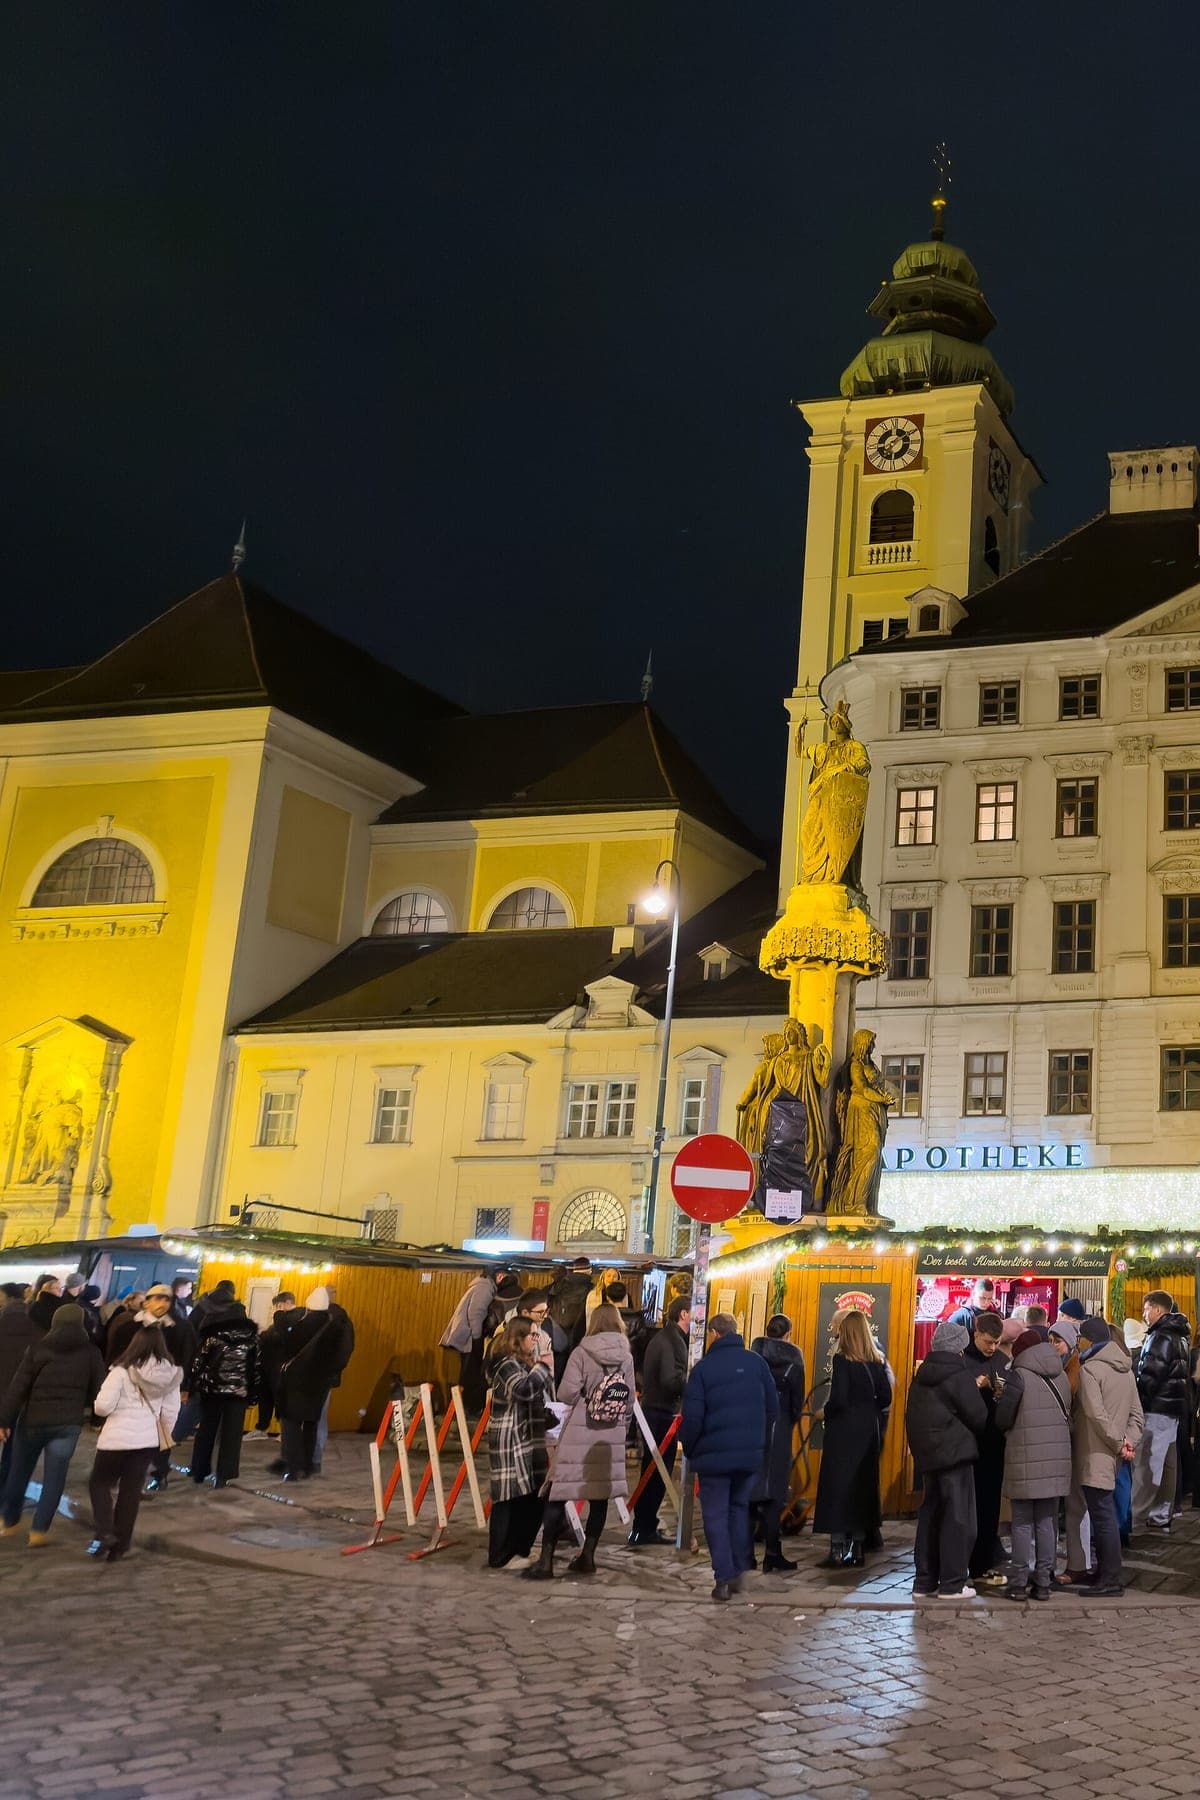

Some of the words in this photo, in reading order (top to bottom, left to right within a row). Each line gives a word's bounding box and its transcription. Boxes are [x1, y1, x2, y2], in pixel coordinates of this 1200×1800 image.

[921, 1254, 943, 1266] Der
[1035, 1259, 1051, 1267] aus
[1053, 1256, 1069, 1267] der
